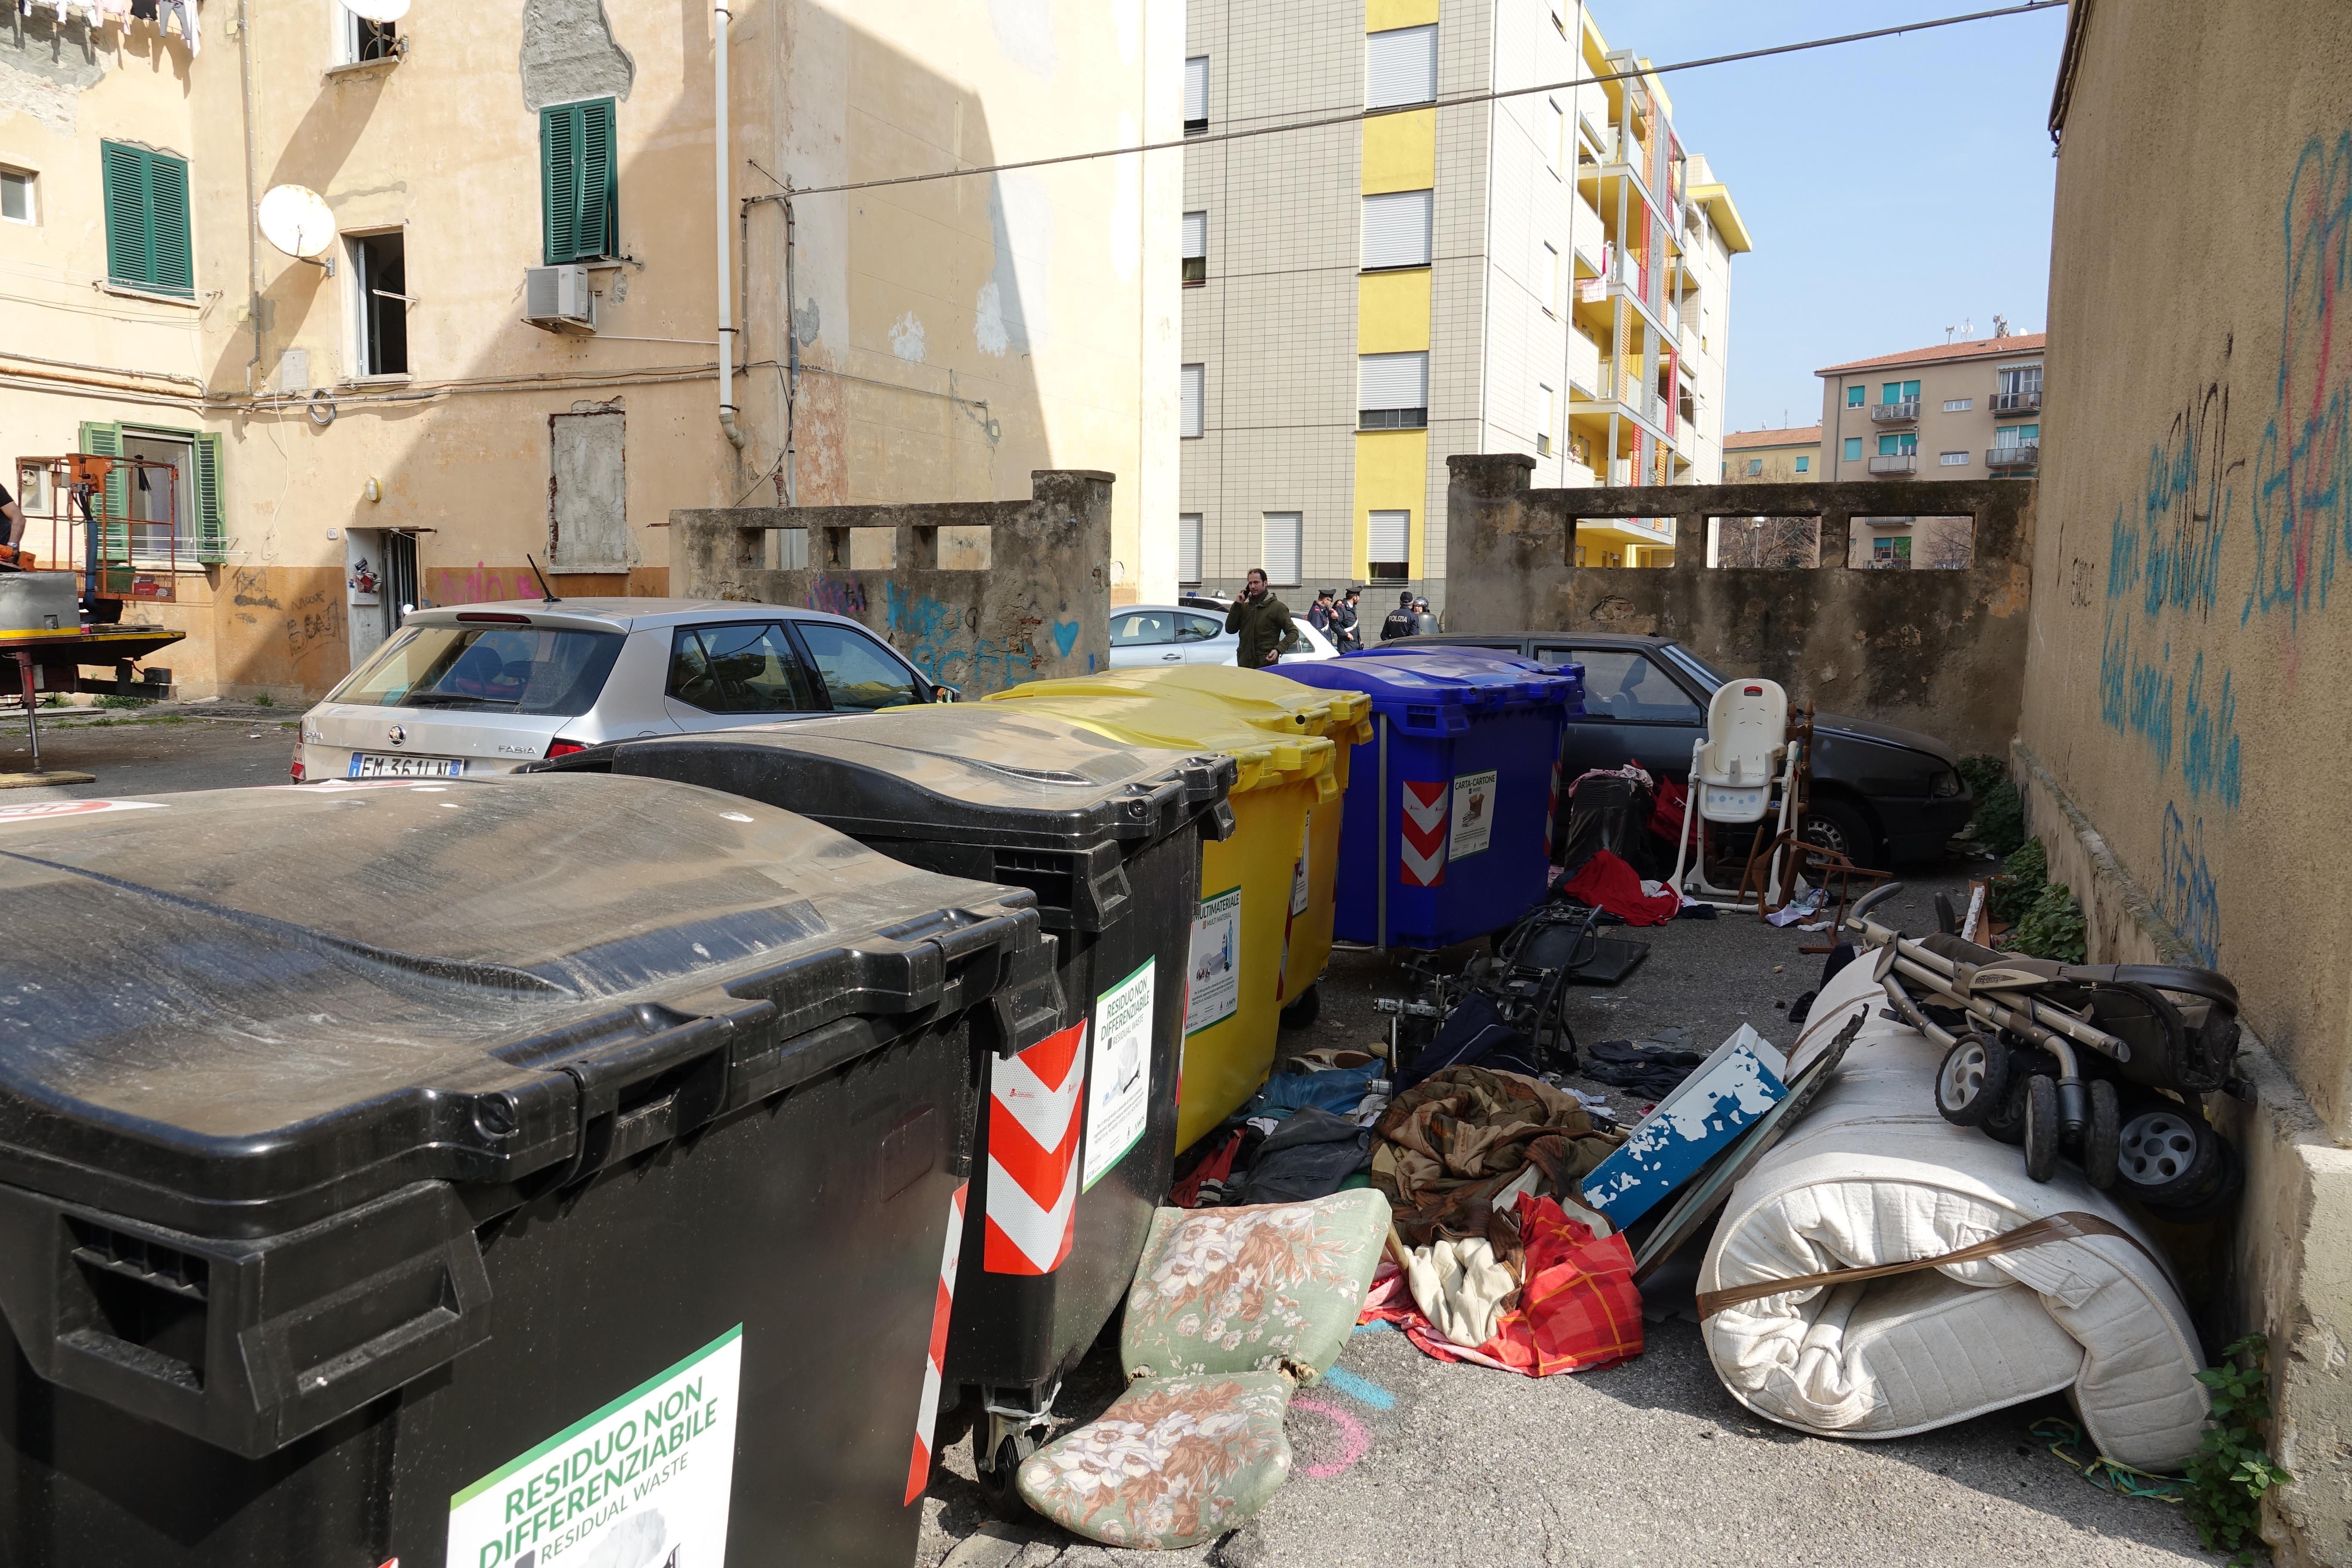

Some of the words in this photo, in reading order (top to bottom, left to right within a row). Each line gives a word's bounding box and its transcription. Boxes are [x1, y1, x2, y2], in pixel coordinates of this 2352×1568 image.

[498, 745, 537, 754] FABIA
[1101, 990, 1150, 1042] DIFFERENZIABILE
[1107, 987, 1134, 1020] RESIDUO
[1135, 976, 1147, 998] NON
[1112, 1024, 1131, 1046] RESIDUAL
[1132, 1014, 1144, 1031] WASTE
[505, 1420, 637, 1525] RESIDUO
[643, 1375, 703, 1438] NON
[478, 1396, 718, 1568] DIFFERENZIABILE
[540, 1500, 628, 1565] RESIDUAL
[634, 1452, 689, 1502] WASTE
